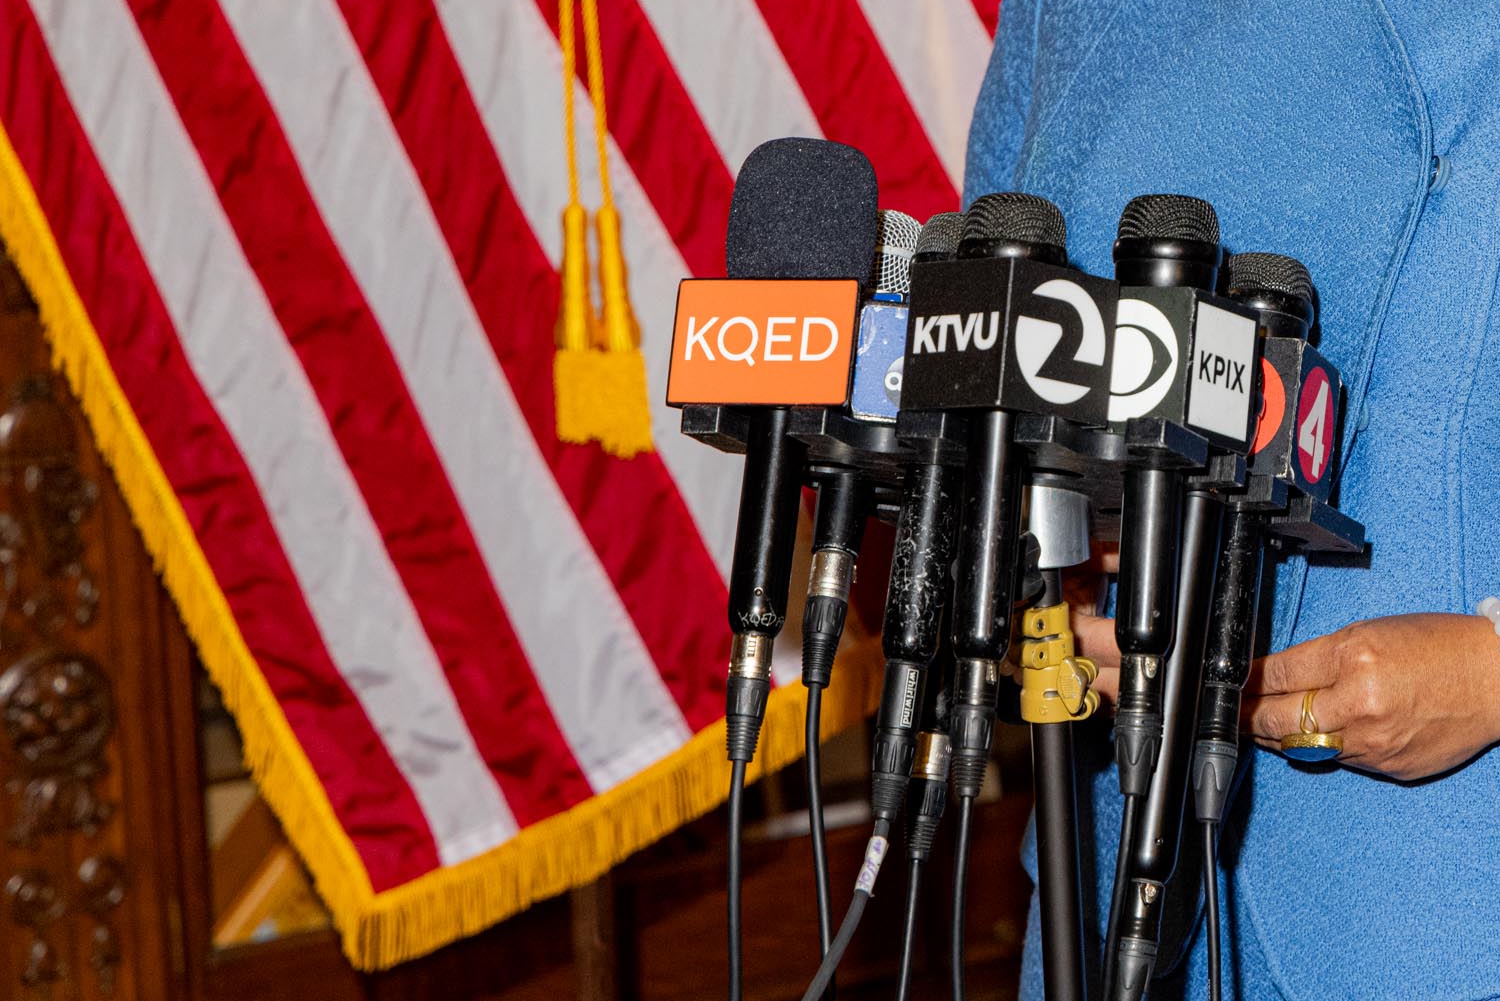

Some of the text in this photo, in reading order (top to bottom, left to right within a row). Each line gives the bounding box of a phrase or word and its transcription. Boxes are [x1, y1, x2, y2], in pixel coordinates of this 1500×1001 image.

[684, 316, 839, 367] KQED
[912, 311, 1000, 354] KTVU
[1198, 350, 1246, 394] KPIX
[1299, 380, 1329, 478] 4
[902, 671, 917, 726] whirlwind
